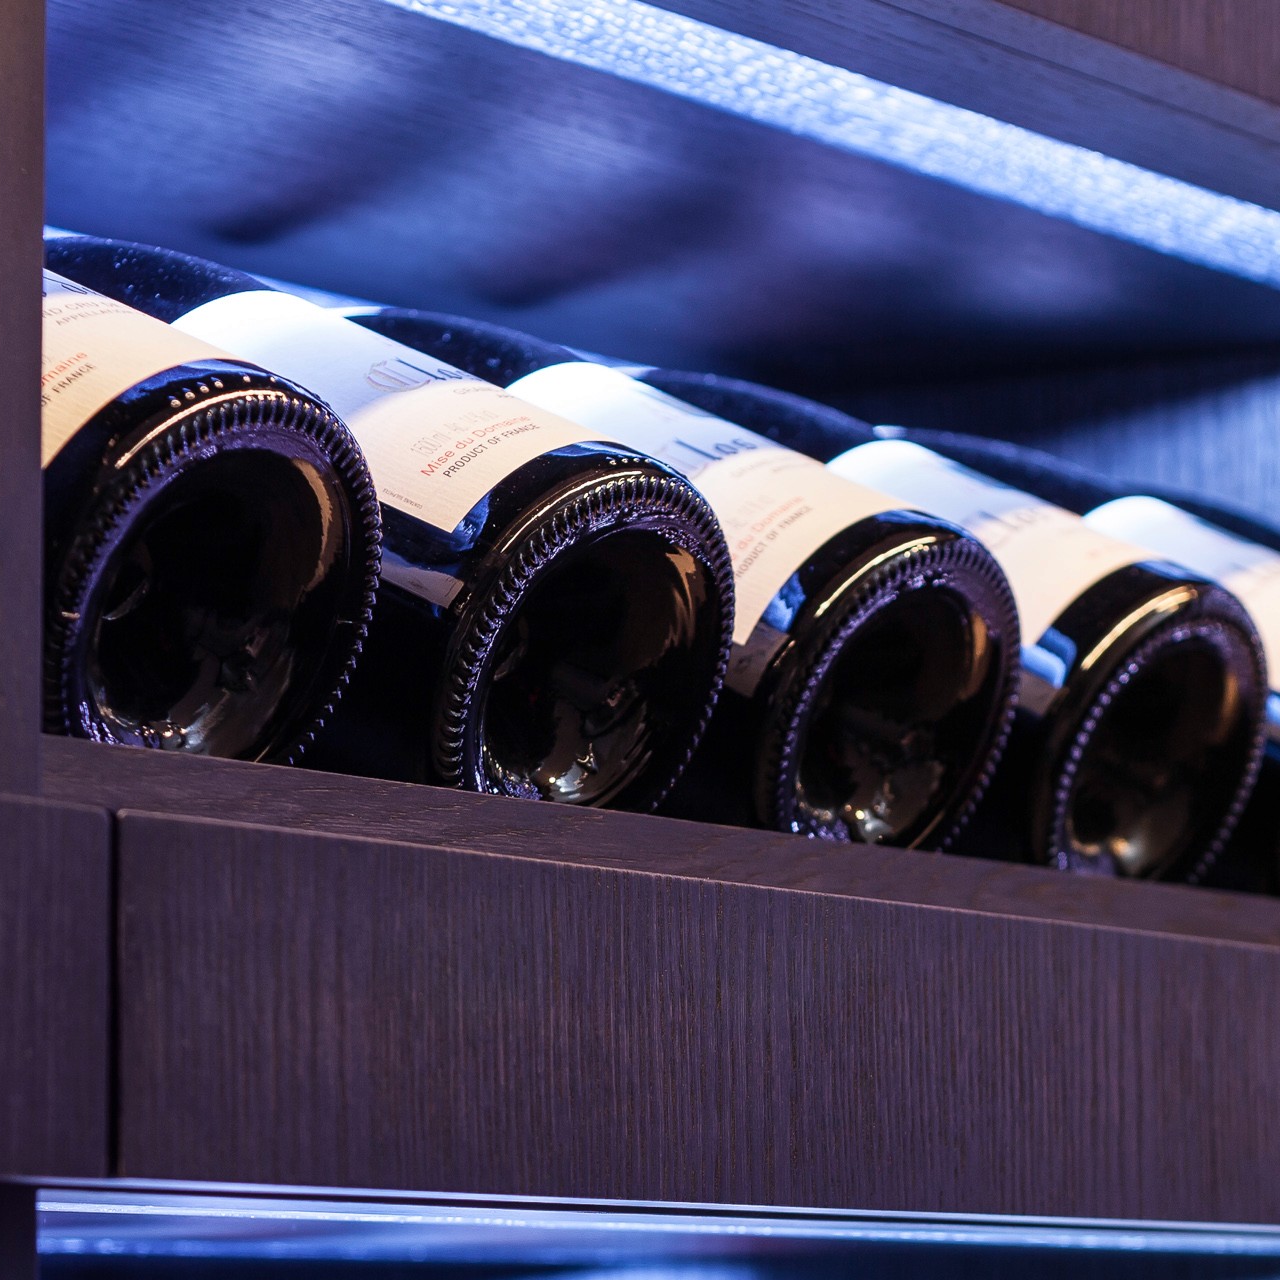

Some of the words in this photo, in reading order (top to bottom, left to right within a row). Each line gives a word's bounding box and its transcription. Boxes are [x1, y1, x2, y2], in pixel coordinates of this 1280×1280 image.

[52, 362, 96, 393] FRANCE
[420, 449, 455, 477] Mise
[455, 434, 475, 450] du
[472, 414, 532, 438] Domaine
[442, 444, 488, 478] PRODUCT
[488, 434, 503, 445] OF
[502, 422, 540, 438] FRANCE
